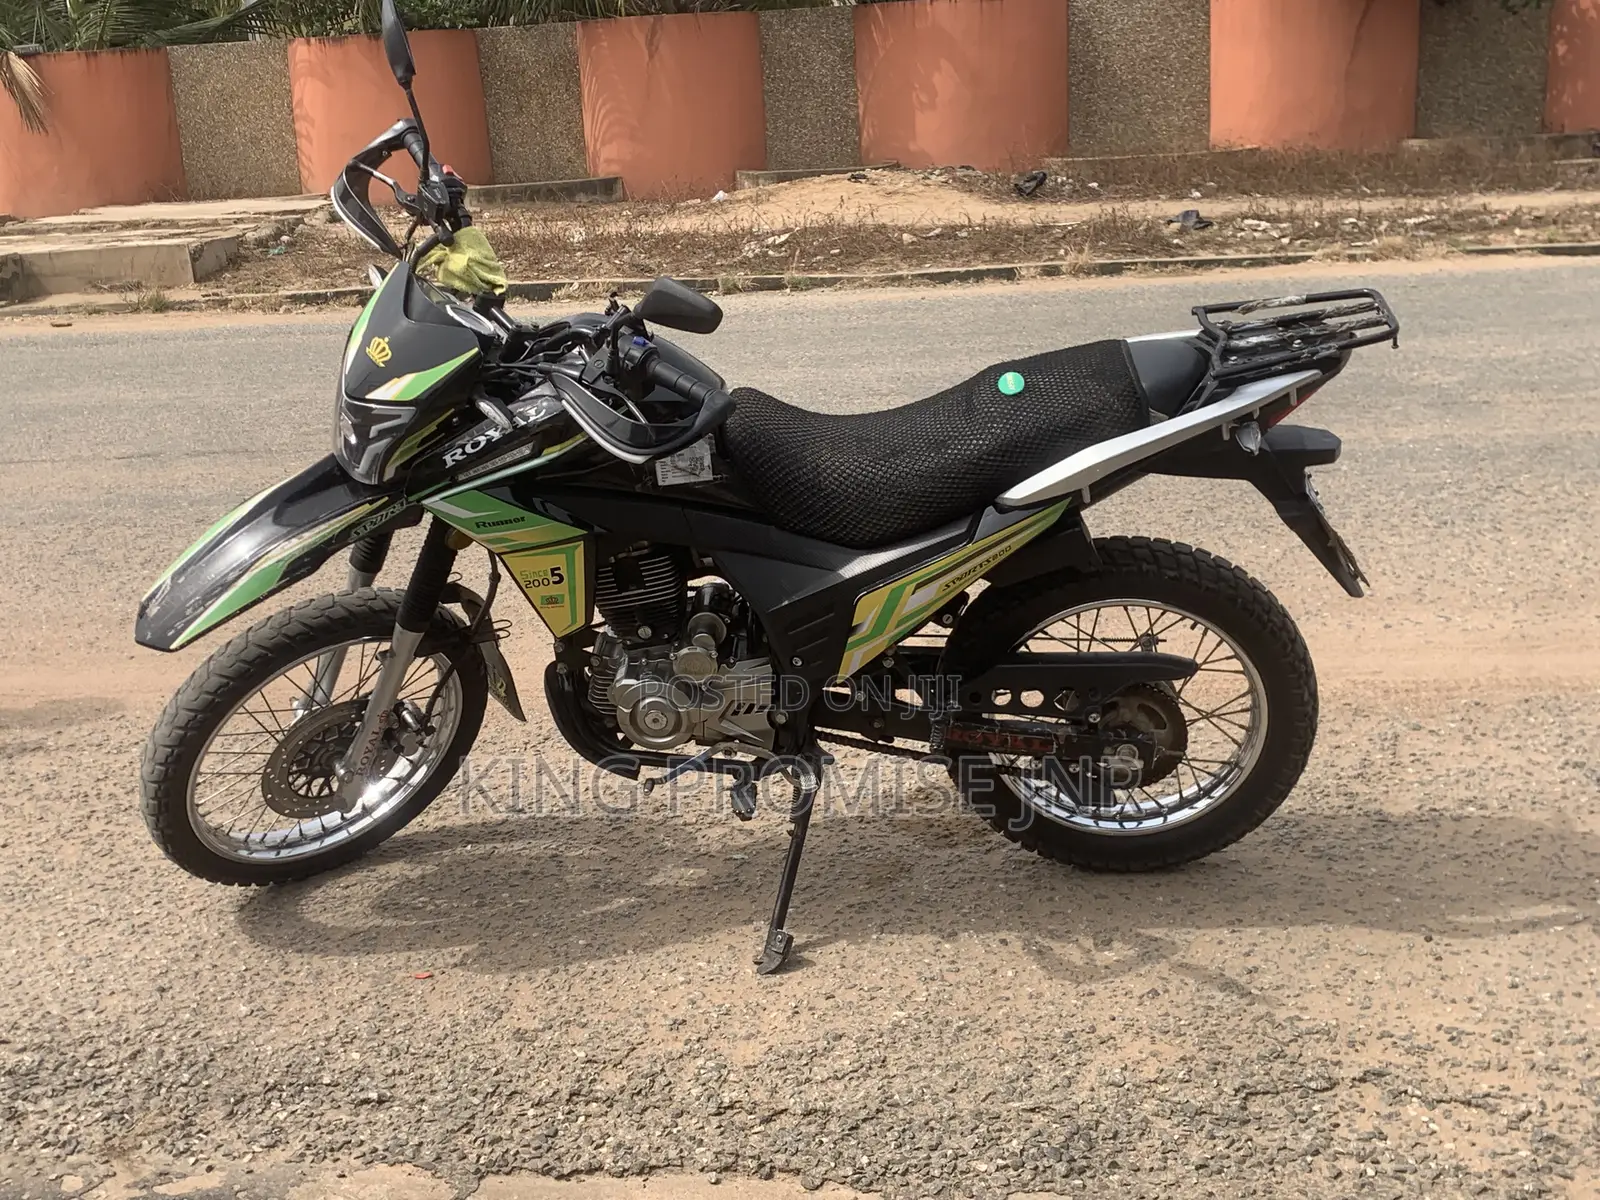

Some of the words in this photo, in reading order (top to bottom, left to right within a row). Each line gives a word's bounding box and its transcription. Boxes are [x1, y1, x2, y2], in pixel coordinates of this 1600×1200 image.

[474, 516, 526, 529] Runner
[520, 569, 549, 580] Since
[523, 566, 565, 589] 2005
[356, 727, 381, 776] ROYAL
